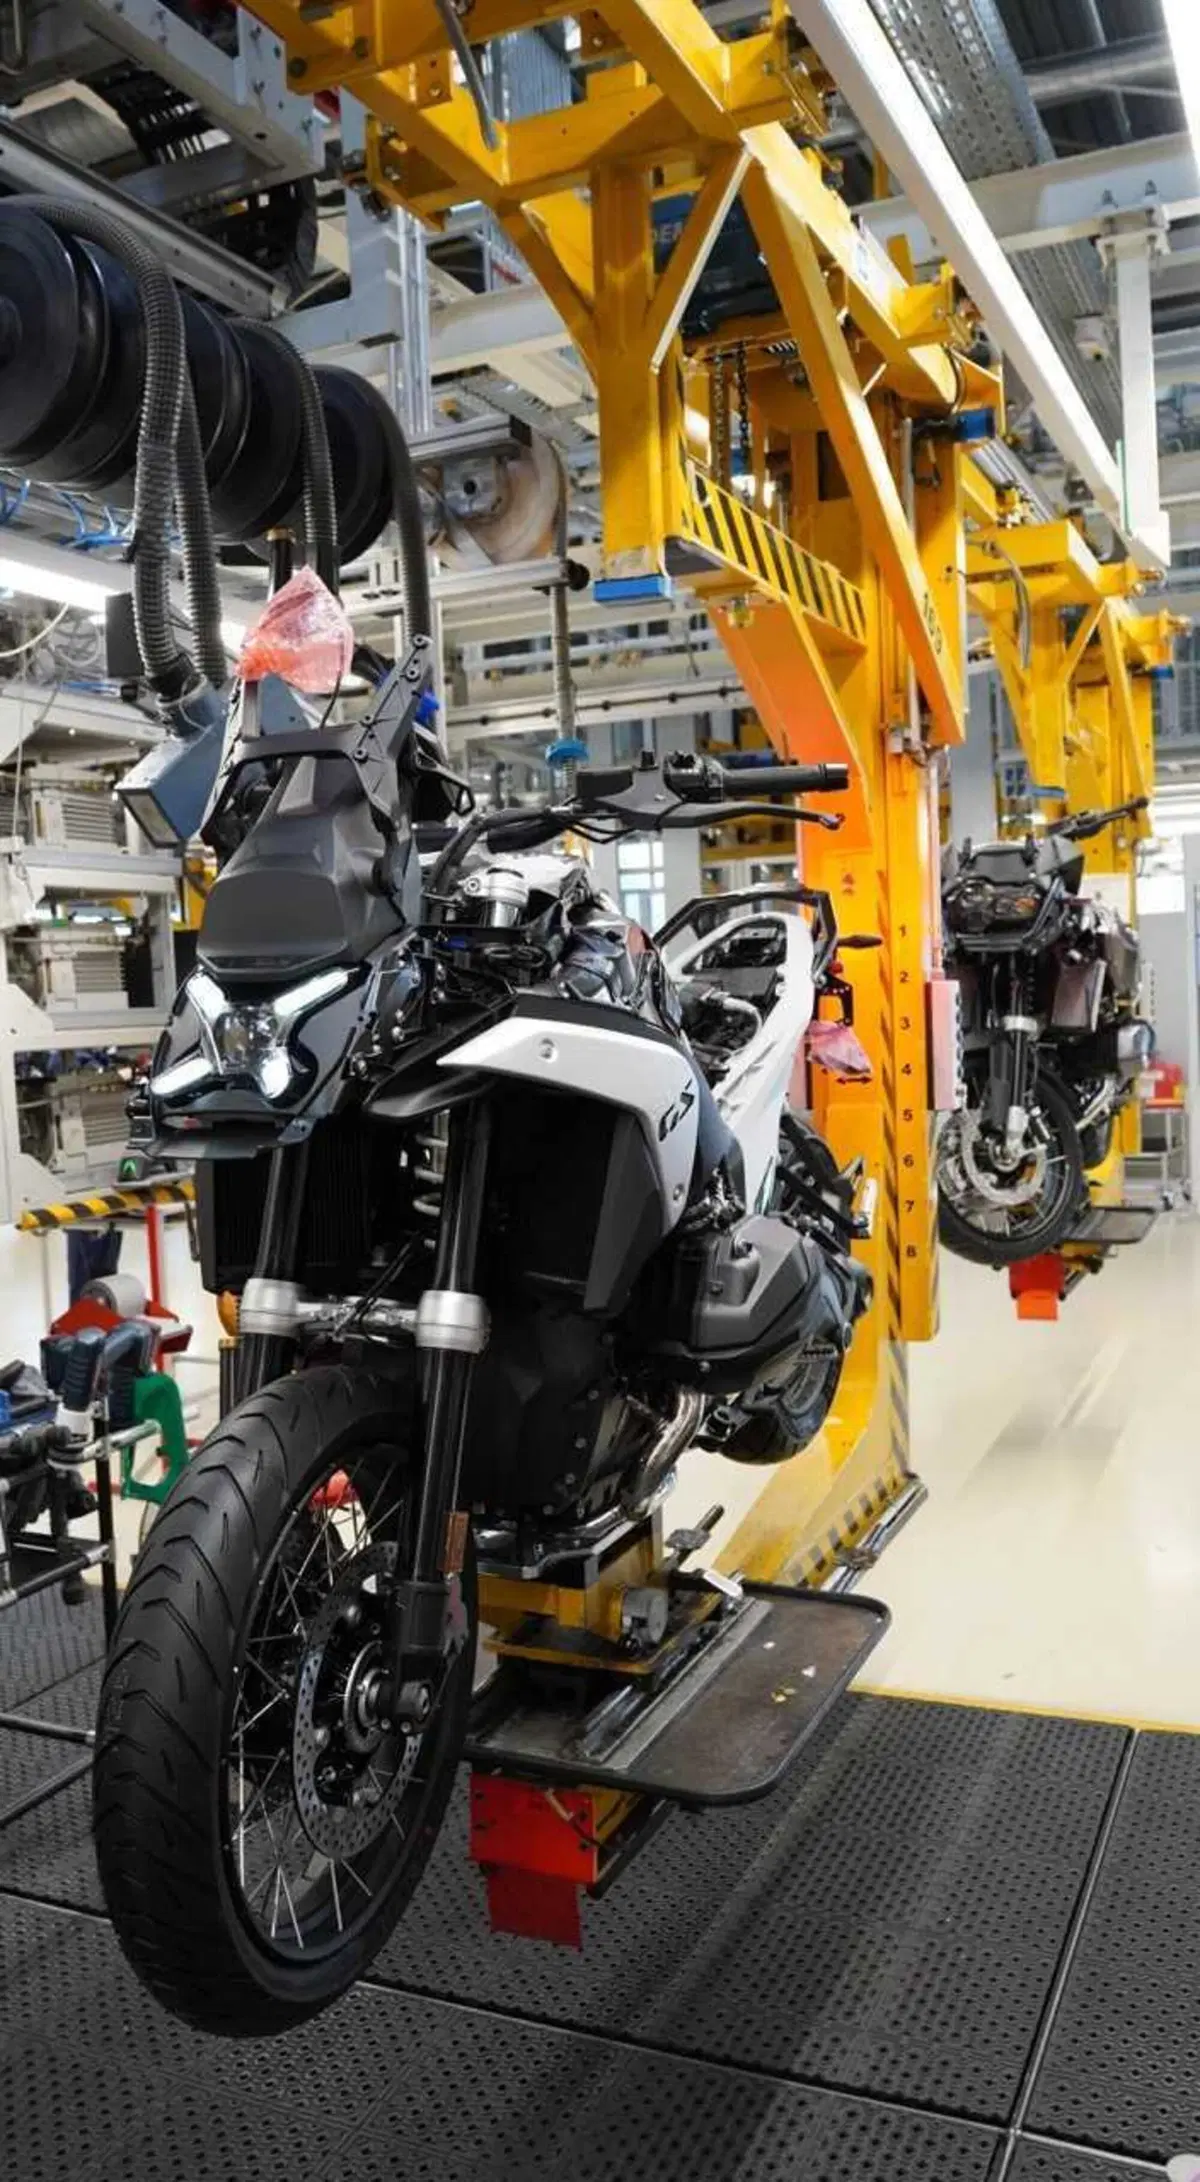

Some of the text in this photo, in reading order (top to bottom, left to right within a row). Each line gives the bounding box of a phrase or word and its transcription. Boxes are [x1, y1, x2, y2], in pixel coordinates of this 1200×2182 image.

[899, 924, 907, 937] 1
[899, 970, 909, 984] 2
[900, 1016, 911, 1031] 3
[901, 1063, 912, 1077] 4
[659, 1079, 695, 1143] GS
[903, 1108, 913, 1122] 5
[903, 1153, 914, 1168] 6
[904, 1199, 915, 1213] 7
[906, 1245, 917, 1258] 8
